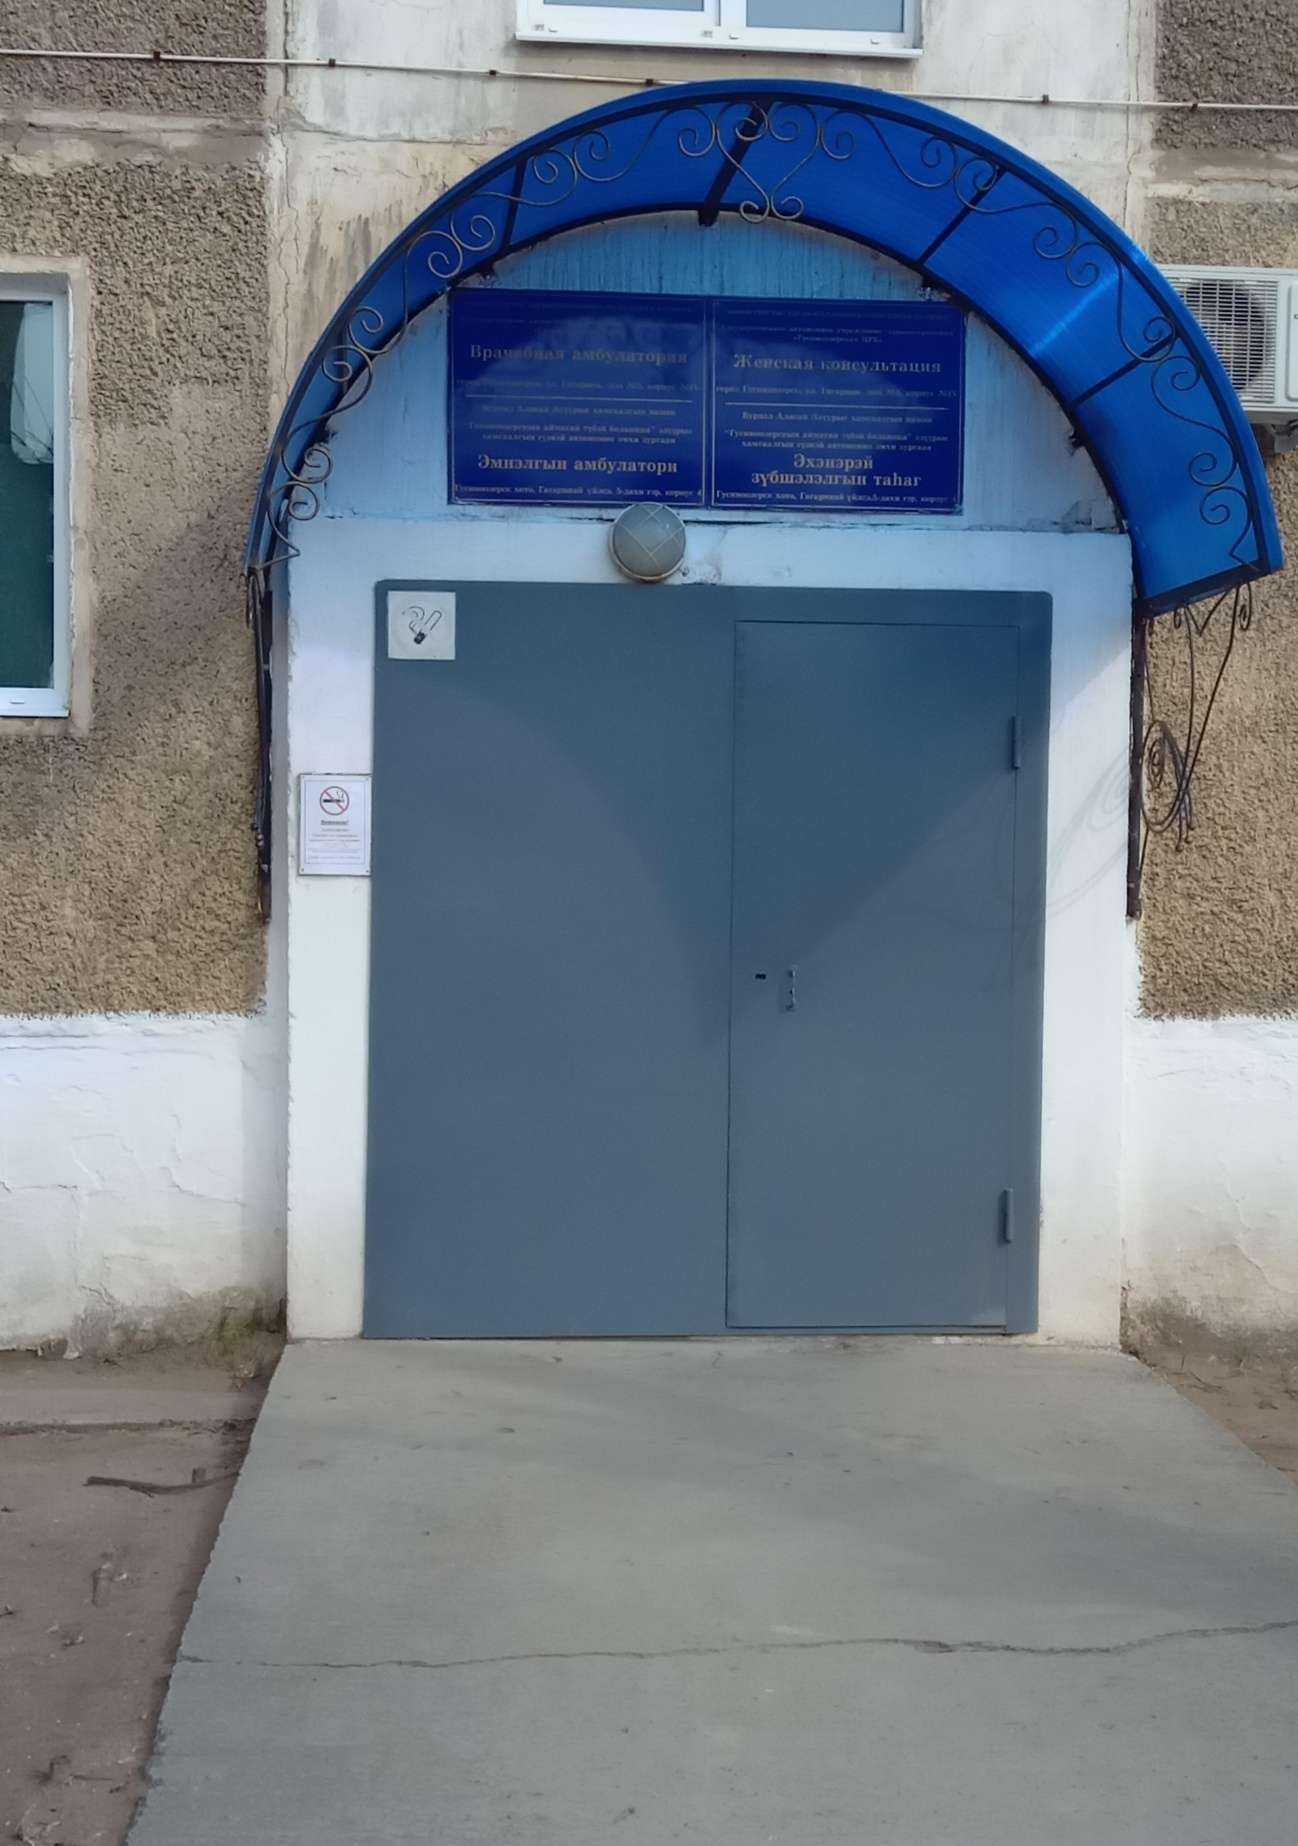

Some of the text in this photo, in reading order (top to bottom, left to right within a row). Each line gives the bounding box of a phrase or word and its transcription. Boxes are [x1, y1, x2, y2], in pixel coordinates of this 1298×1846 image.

[733, 353, 942, 376] Женская консультация
[574, 457, 678, 476] амбулатори
